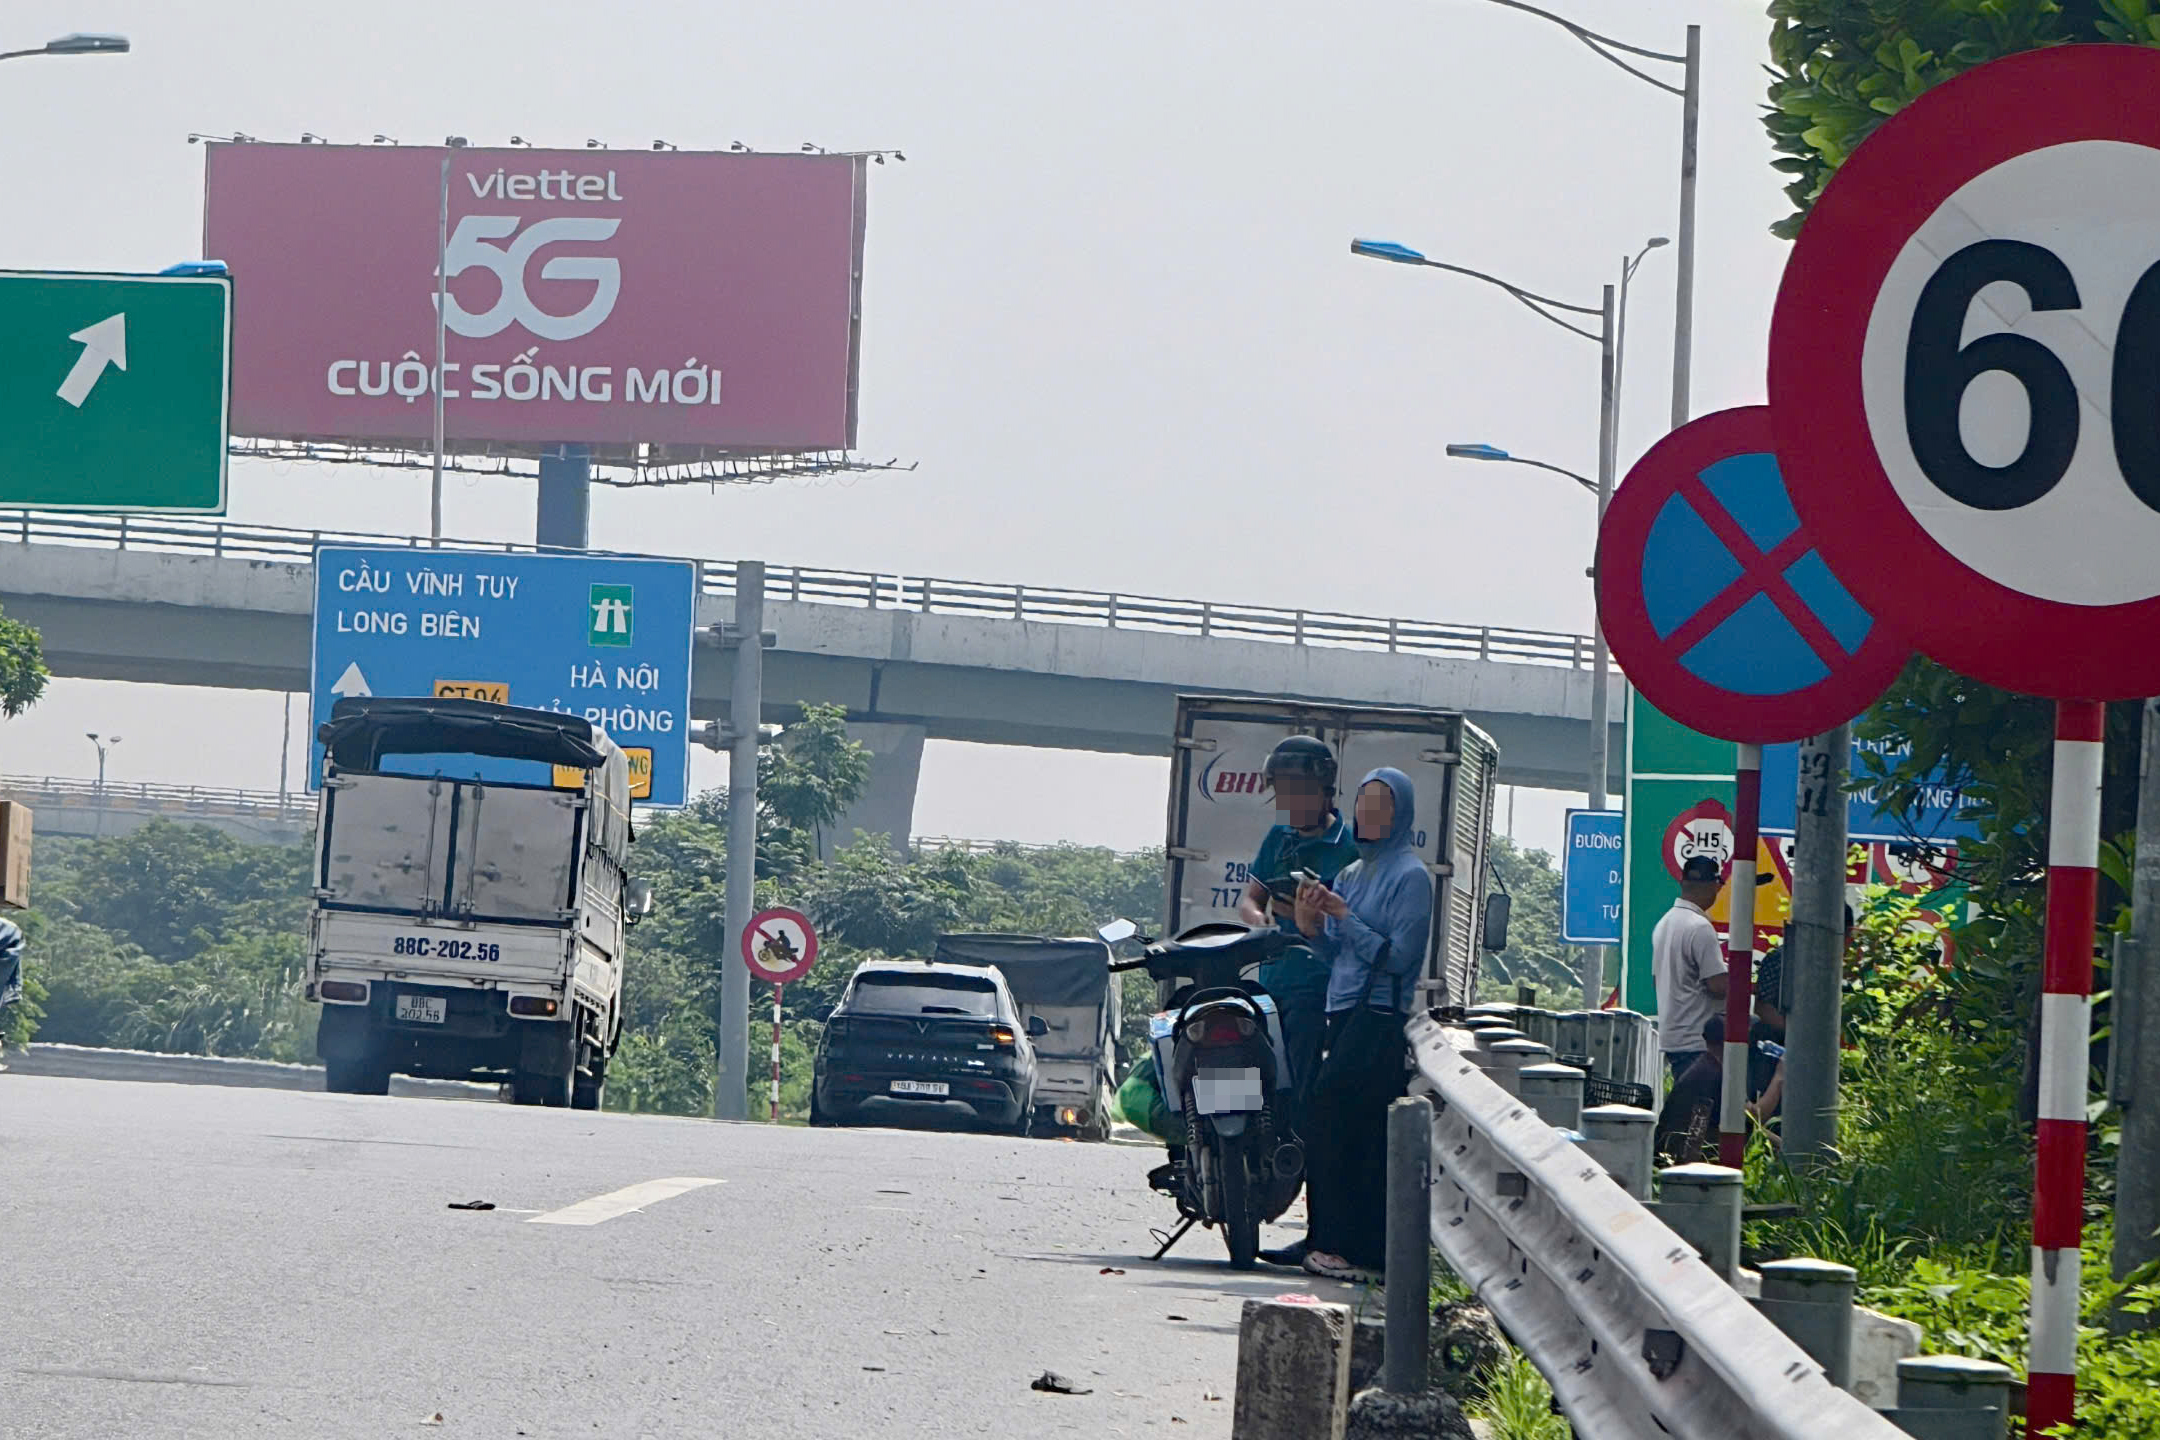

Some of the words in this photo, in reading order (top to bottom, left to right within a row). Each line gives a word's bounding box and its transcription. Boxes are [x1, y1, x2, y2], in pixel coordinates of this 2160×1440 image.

[467, 169, 623, 201] viettel
[432, 215, 621, 340] 5G
[327, 350, 460, 404] CUỘC
[471, 346, 612, 403] SỐNG
[626, 357, 721, 405] MỚI
[1904, 239, 2160, 515] 6
[339, 558, 390, 593] CẦU
[406, 567, 463, 597] VĨNH
[476, 575, 519, 600] TUY
[337, 610, 408, 635] LONG
[421, 610, 480, 639] BIÊN
[571, 660, 606, 690] HÀ
[617, 662, 660, 696] NỘI
[1697, 832, 1721, 848] H5
[394, 937, 500, 961] 88C-202.56
